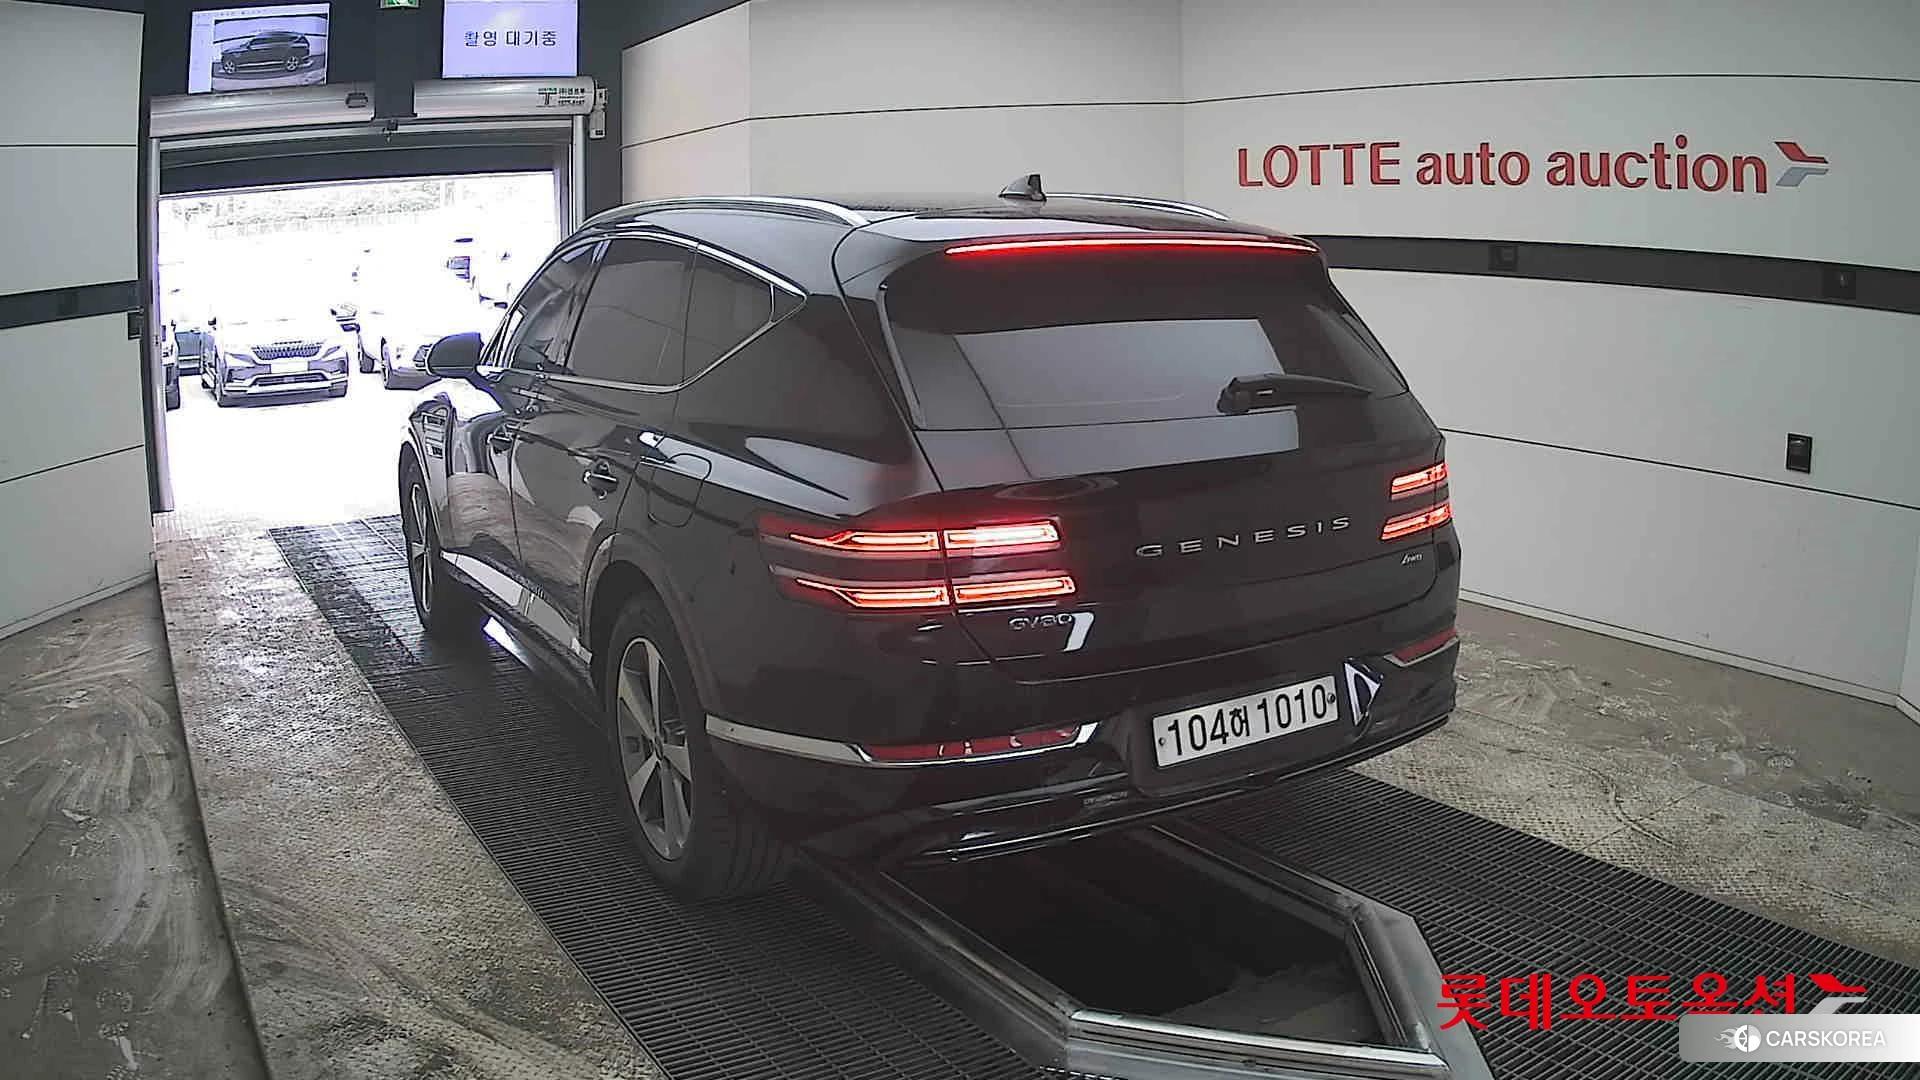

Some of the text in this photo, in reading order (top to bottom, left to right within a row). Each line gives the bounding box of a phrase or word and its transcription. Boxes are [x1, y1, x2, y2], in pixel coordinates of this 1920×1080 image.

[506, 30, 557, 46] 대기중
[1238, 134, 1767, 194] LOTTE auto auction
[1136, 516, 1351, 557] GENESIS
[1167, 684, 1327, 756] 104허 1010
